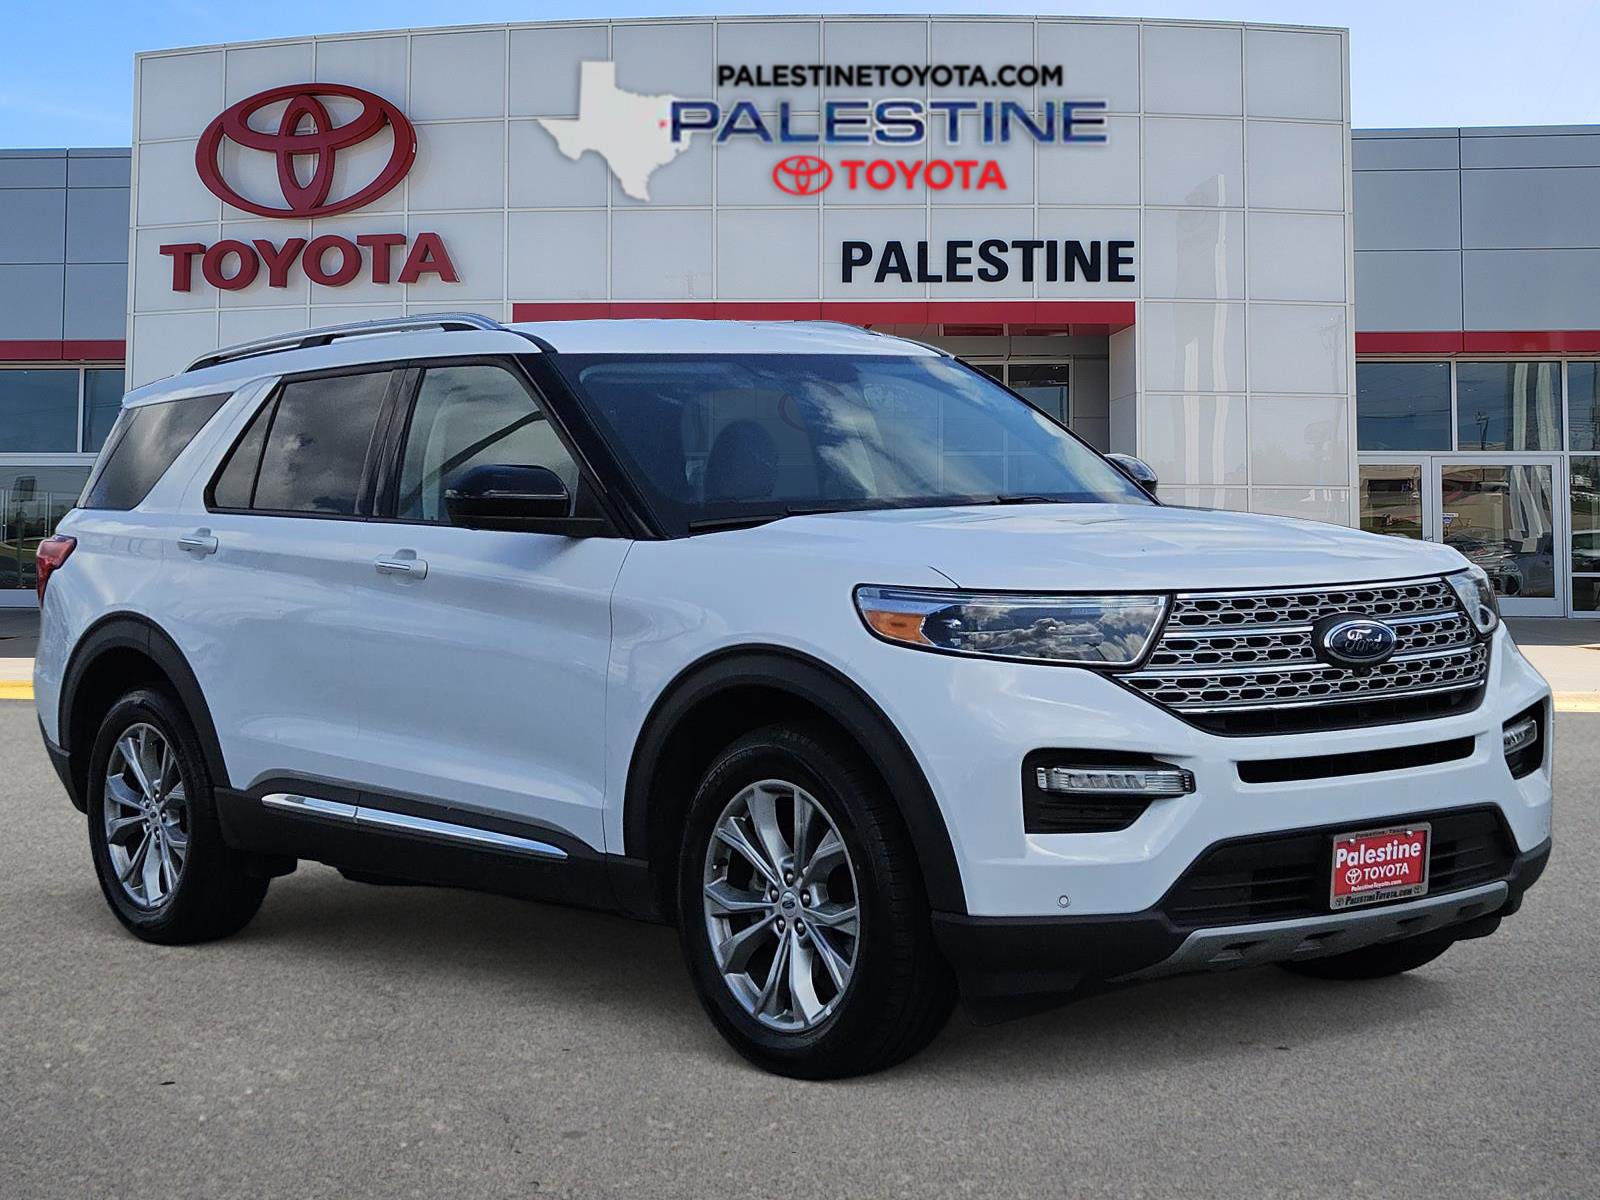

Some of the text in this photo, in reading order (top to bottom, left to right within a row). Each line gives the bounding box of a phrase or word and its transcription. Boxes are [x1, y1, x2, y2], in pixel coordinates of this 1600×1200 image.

[160, 232, 460, 292] TOYOTA
[841, 240, 1135, 283] PALESTINE
[1336, 840, 1421, 868] Palestine
[1363, 863, 1409, 880] TOYOTA
